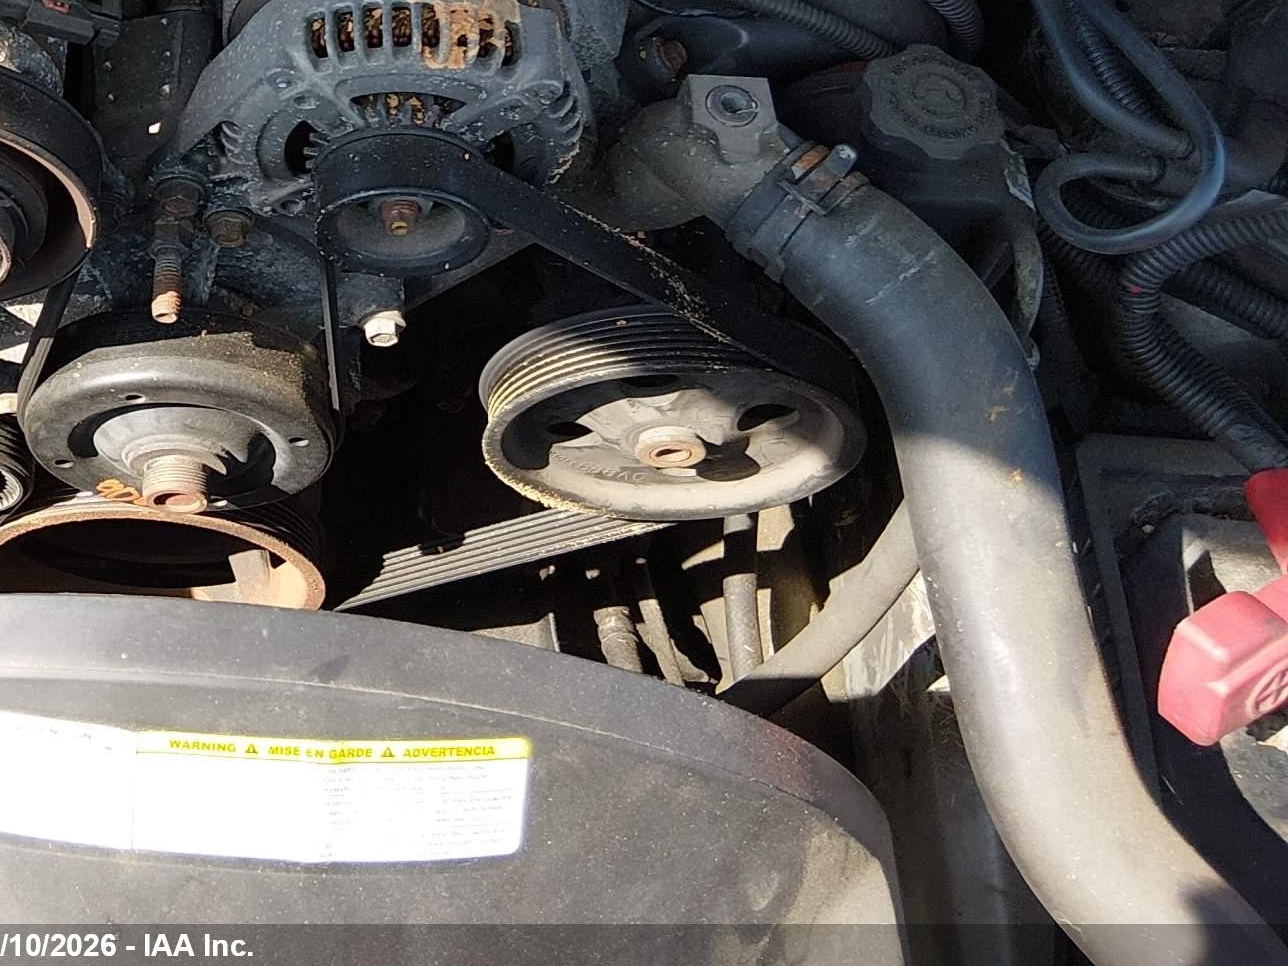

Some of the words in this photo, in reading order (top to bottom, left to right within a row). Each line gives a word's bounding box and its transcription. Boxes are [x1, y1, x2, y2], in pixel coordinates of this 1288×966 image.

[169, 738, 237, 753] WARNING
[268, 745, 301, 756] MISE
[306, 748, 324, 759] EN
[328, 747, 373, 759] GARDE
[403, 745, 495, 758] ADVERTENCIA
